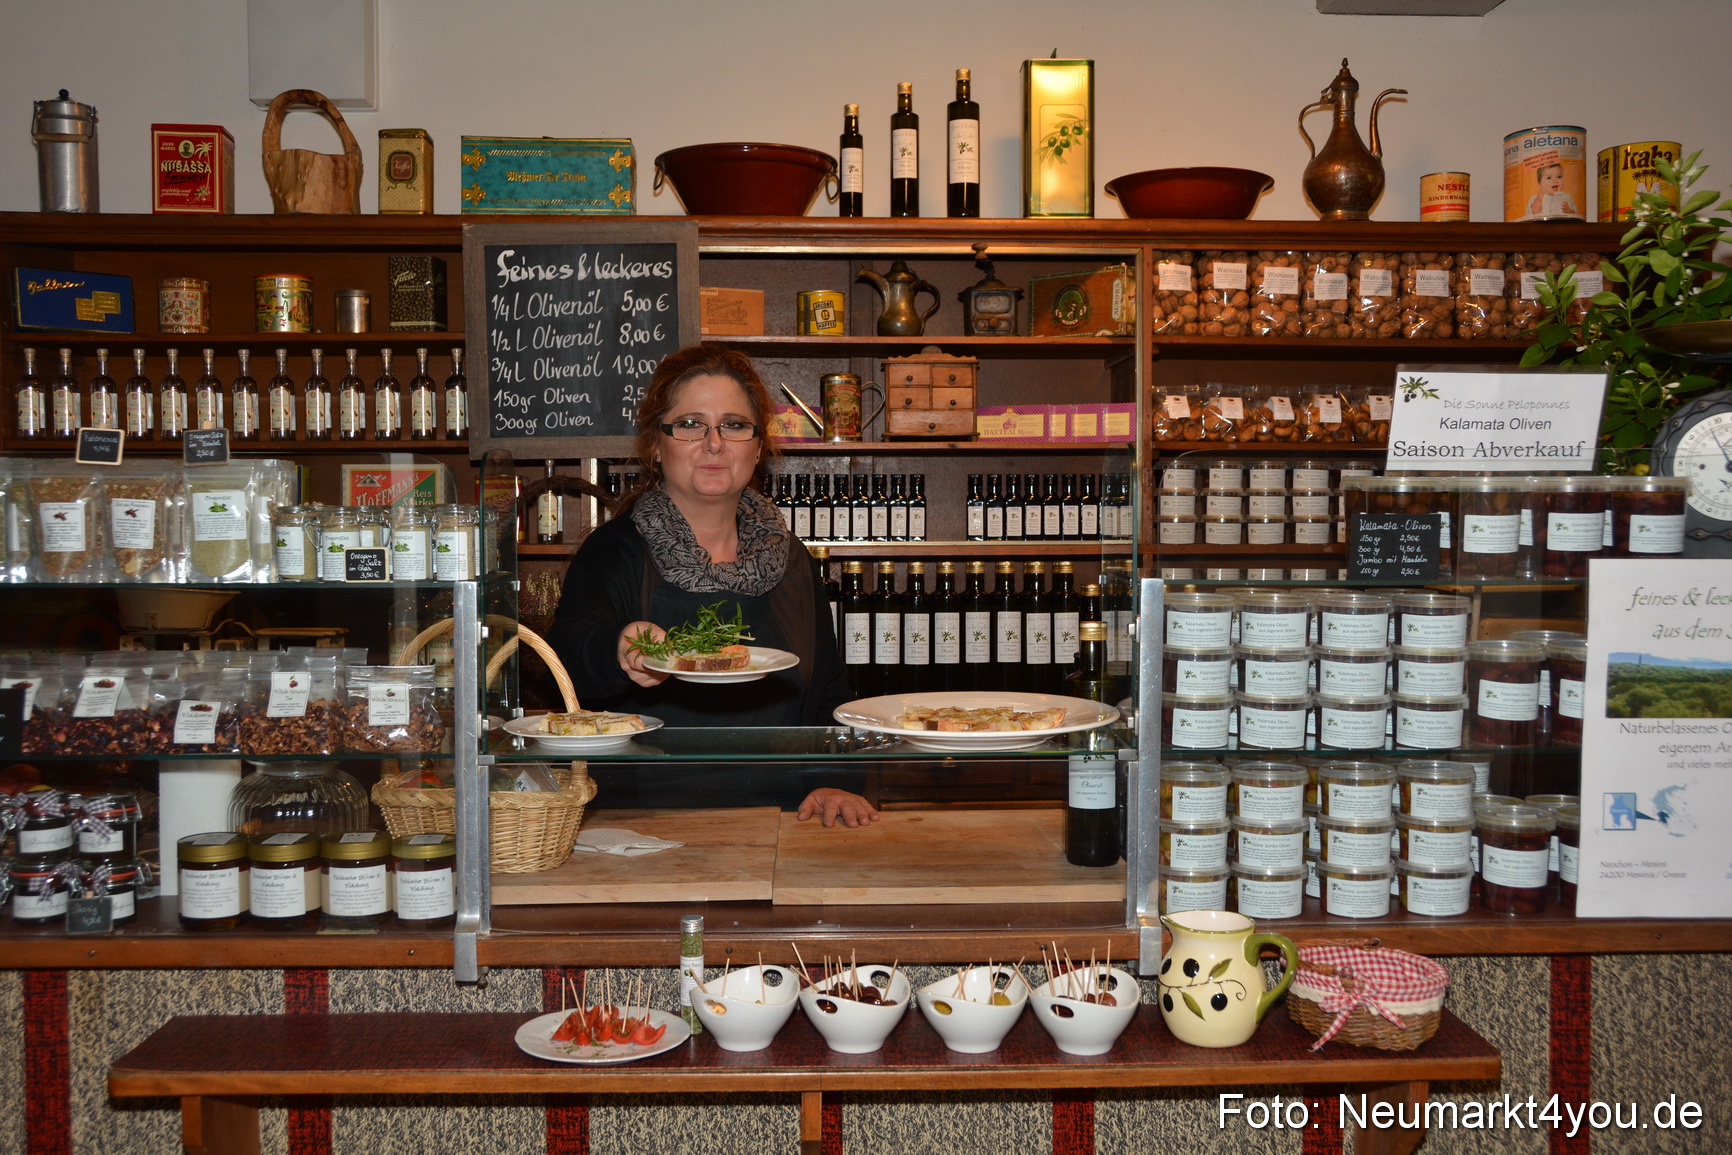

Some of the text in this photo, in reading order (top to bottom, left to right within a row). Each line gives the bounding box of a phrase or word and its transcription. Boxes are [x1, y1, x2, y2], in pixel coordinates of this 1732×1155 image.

[1524, 135, 1578, 149] aletana
[161, 160, 212, 173] NUBASSA
[595, 252, 672, 280] leckeres
[492, 294, 509, 321] 1/4
[528, 289, 604, 319] Olivenöl
[621, 289, 651, 317] 5,00
[656, 293, 669, 312] €
[492, 320, 665, 352] 1/2 L Olivenöl 8,00 €
[534, 352, 603, 380] Olivenöl
[544, 388, 592, 405] Oliven
[622, 385, 646, 406] 2,5
[1444, 400, 1570, 413] Die Sonne Peloponnes
[545, 412, 594, 429] Oliven
[1440, 418, 1552, 430] Kalamata Oliven
[1394, 441, 1586, 458] Saison Abverkauf
[414, 490, 432, 498] Reis
[1405, 519, 1431, 530] Oliven
[1357, 554, 1382, 566] Jumbo
[1626, 587, 1678, 611] feines
[1682, 588, 1702, 606] &
[1652, 624, 1682, 640] aus
[1685, 618, 1723, 640] dem
[1620, 720, 1719, 734] Naturbelassenes
[1659, 743, 1711, 757] eigenem
[1667, 760, 1685, 768] und
[1686, 758, 1711, 768] vieles
